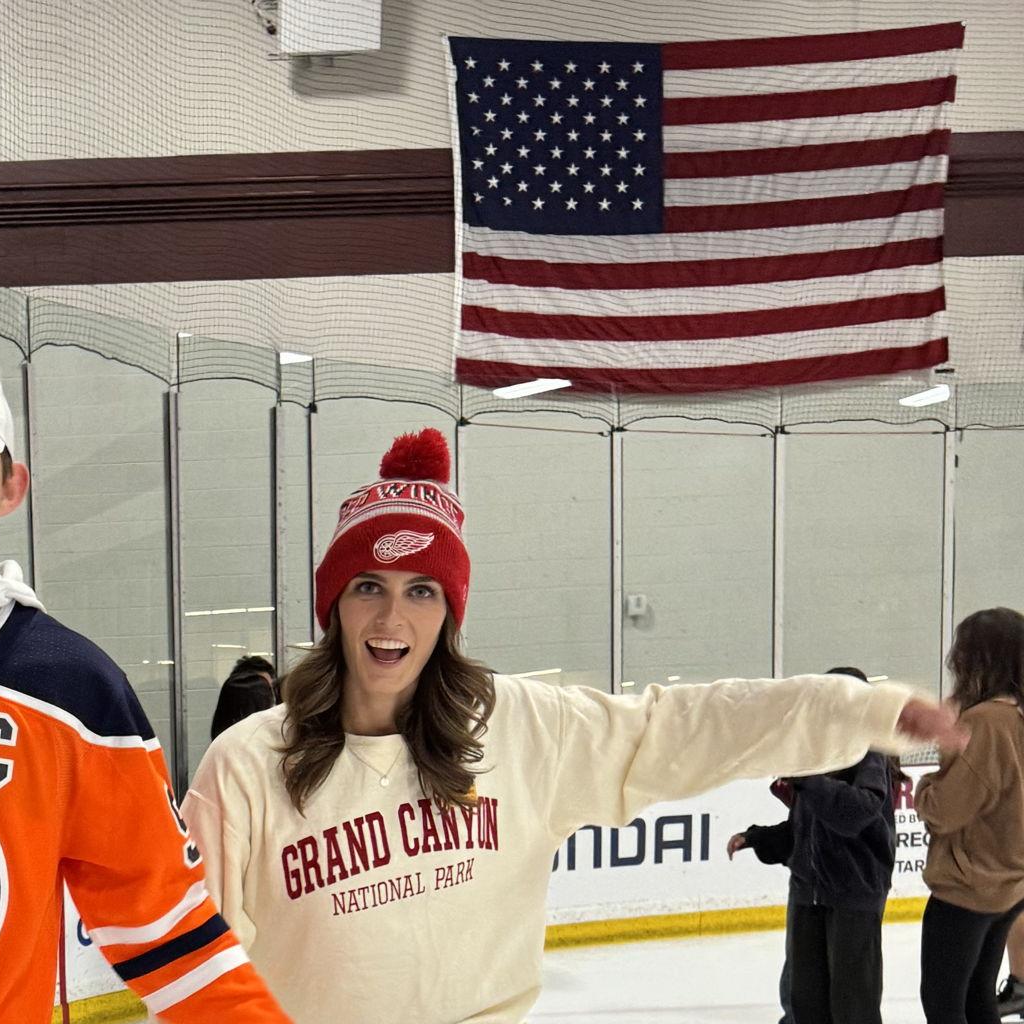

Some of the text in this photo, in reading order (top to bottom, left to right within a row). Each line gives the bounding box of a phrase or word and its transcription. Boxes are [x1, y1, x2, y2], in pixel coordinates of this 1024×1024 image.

[281, 811, 391, 900] GRAND
[397, 796, 499, 857] CANYON
[552, 813, 710, 872] NDAI
[331, 858, 475, 916] NATIONAL PARK
